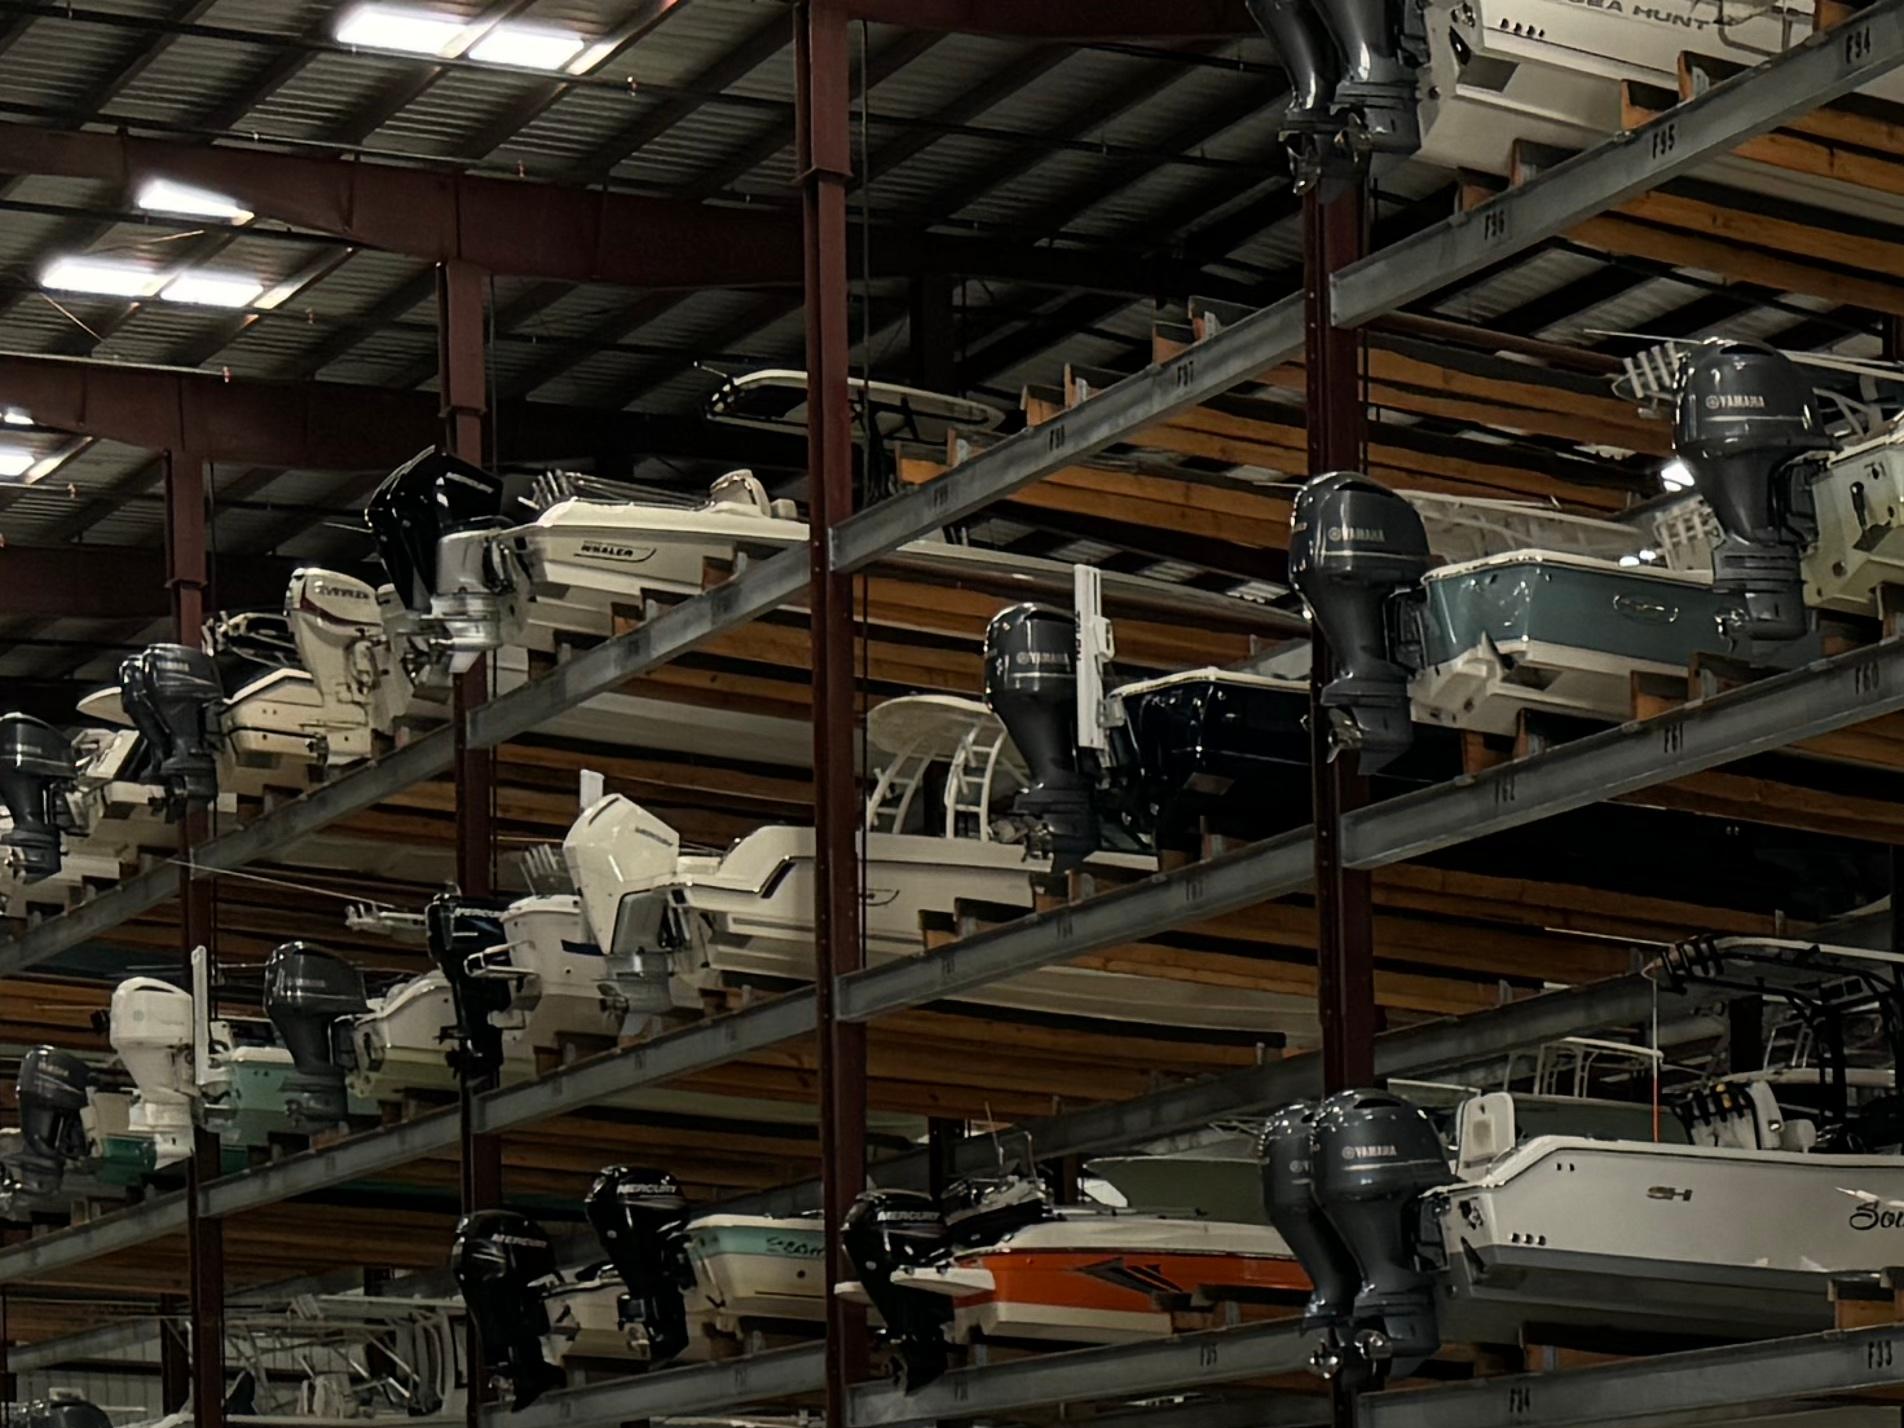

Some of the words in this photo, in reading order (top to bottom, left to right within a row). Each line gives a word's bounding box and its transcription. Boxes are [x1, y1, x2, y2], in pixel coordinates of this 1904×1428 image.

[1569, 0, 1622, 12] EA
[1632, 5, 1710, 30] HUNT
[1653, 124, 1675, 159] F95
[1719, 395, 1766, 408] YAMAHA
[1356, 1145, 1397, 1158] YAMAHA
[877, 1211, 941, 1221] MERCURY
[1868, 1340, 1892, 1369] F33
